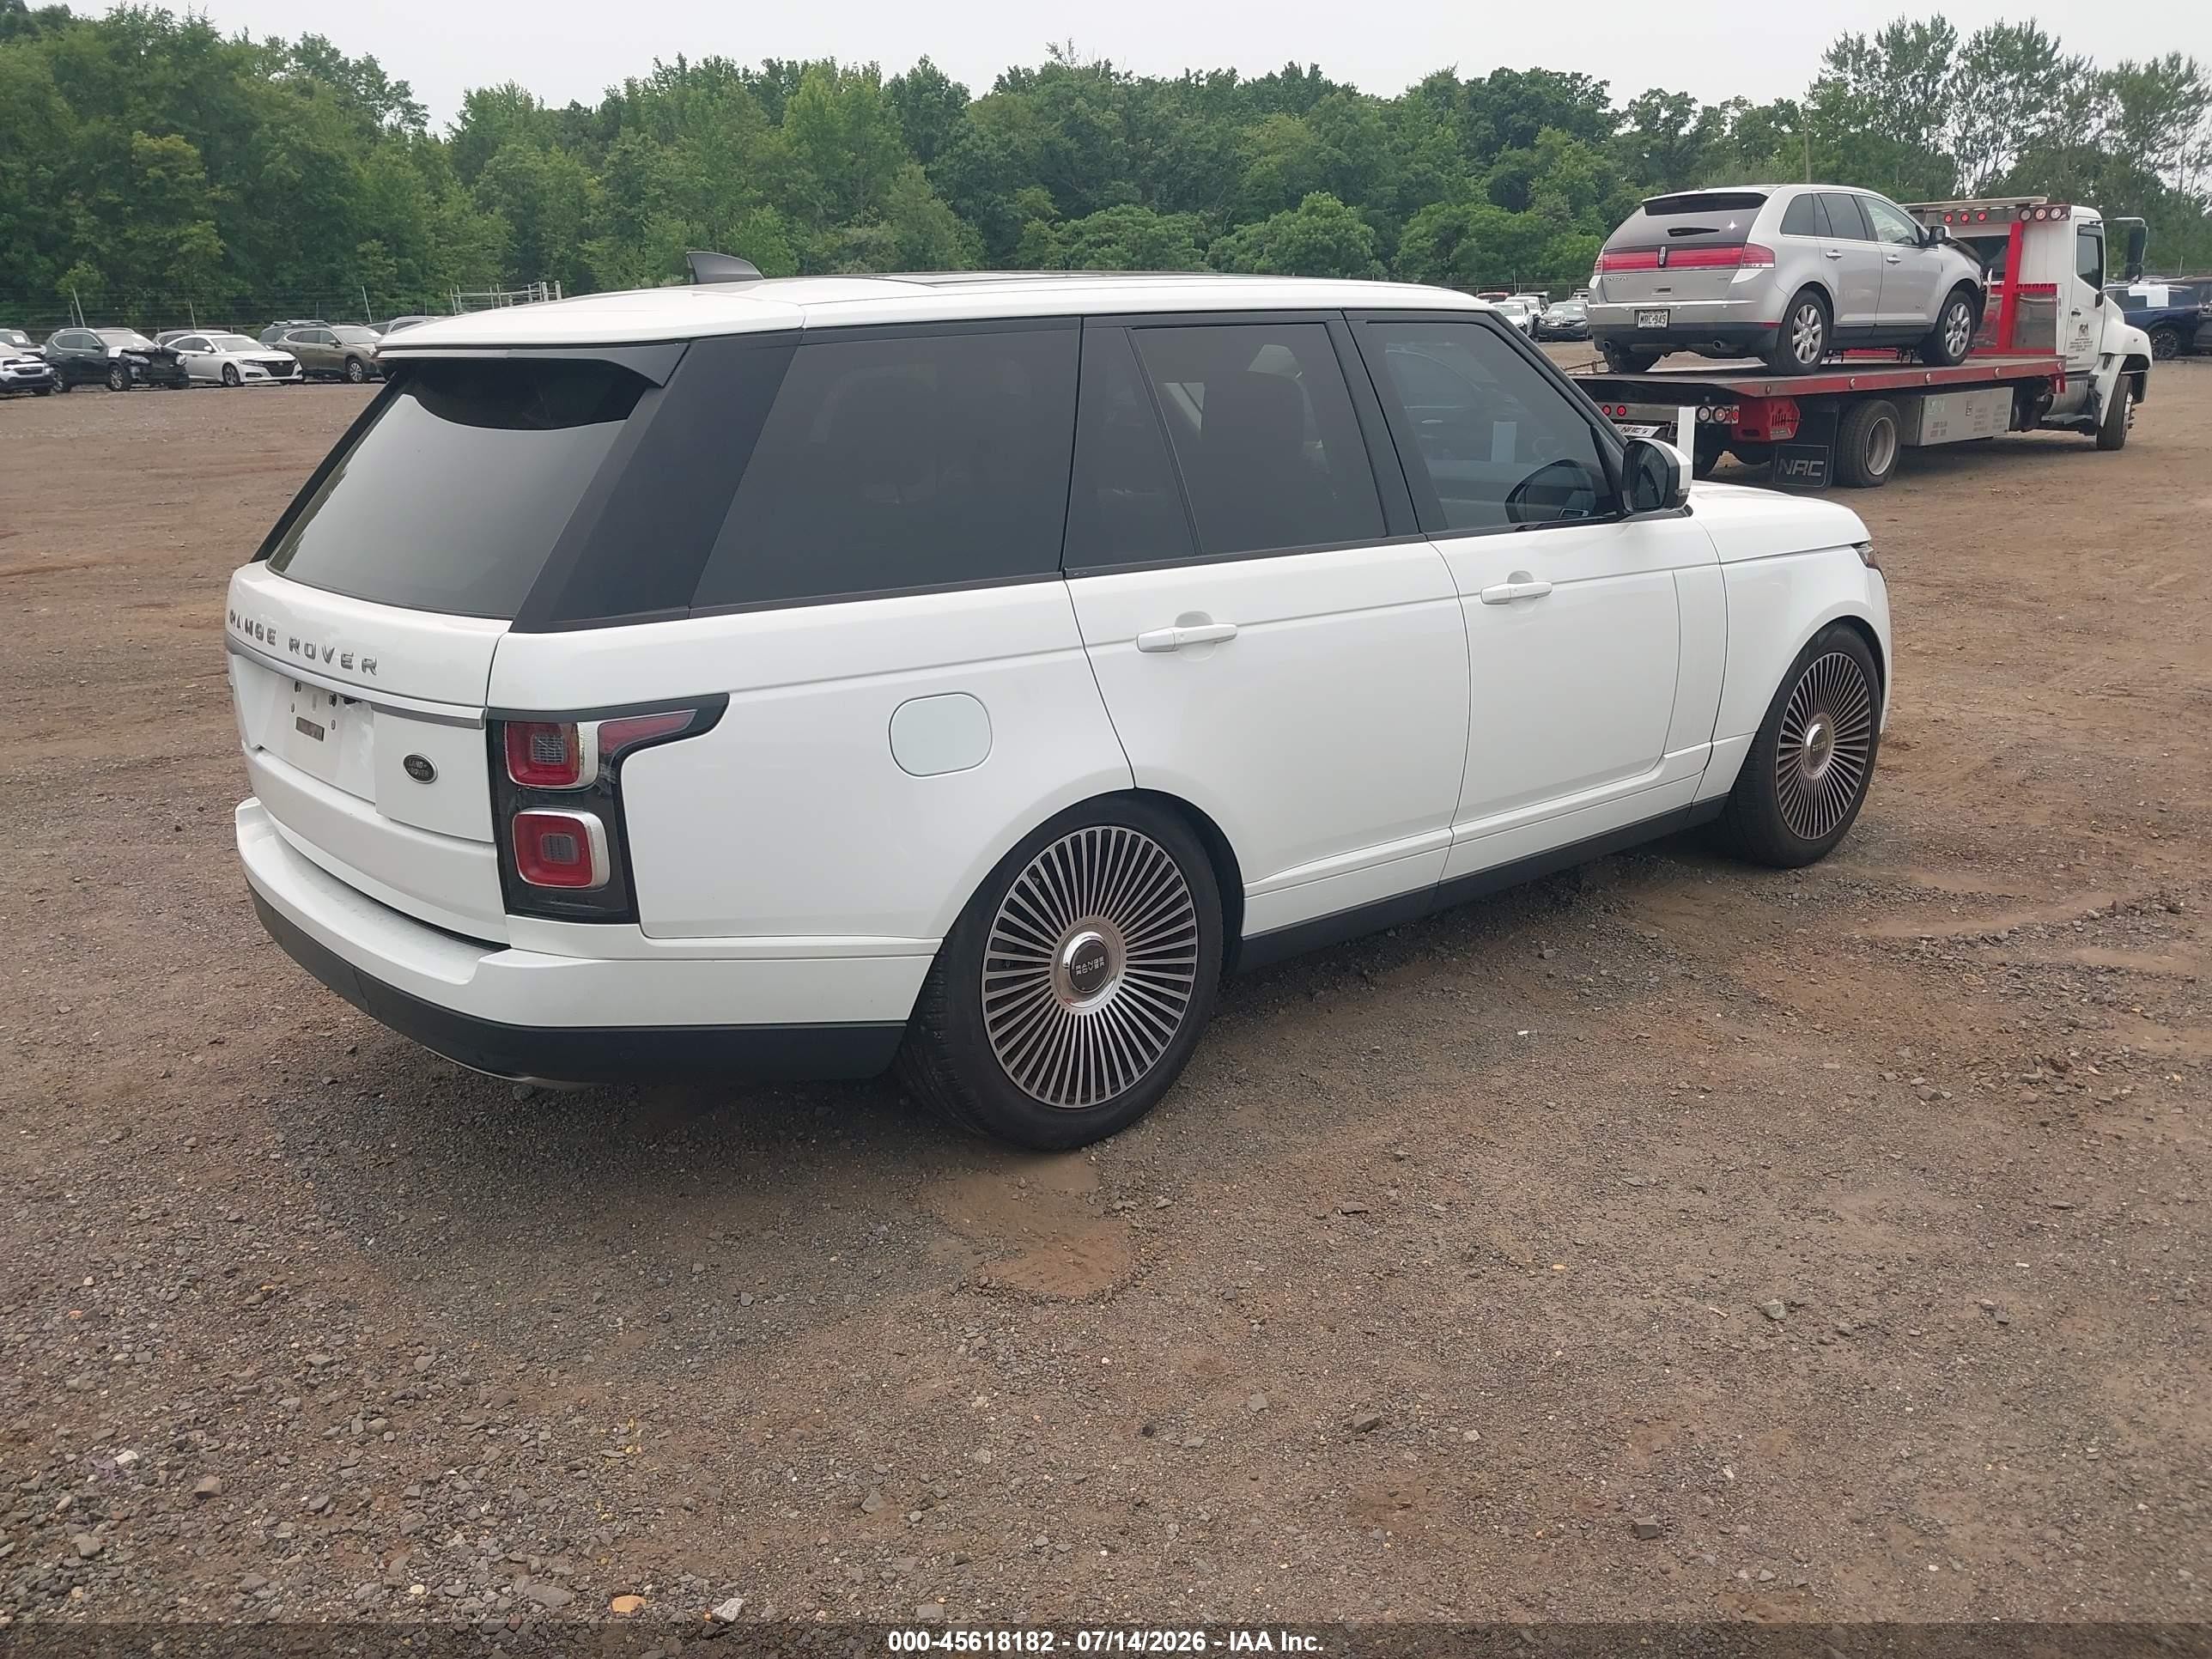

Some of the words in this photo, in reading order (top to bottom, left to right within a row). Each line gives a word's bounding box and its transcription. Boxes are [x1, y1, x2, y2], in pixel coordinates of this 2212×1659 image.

[228, 609, 276, 646] RANGE
[289, 636, 377, 676] ROVER
[1075, 956, 1104, 970] RANGE
[1076, 962, 1105, 975] ROVER
